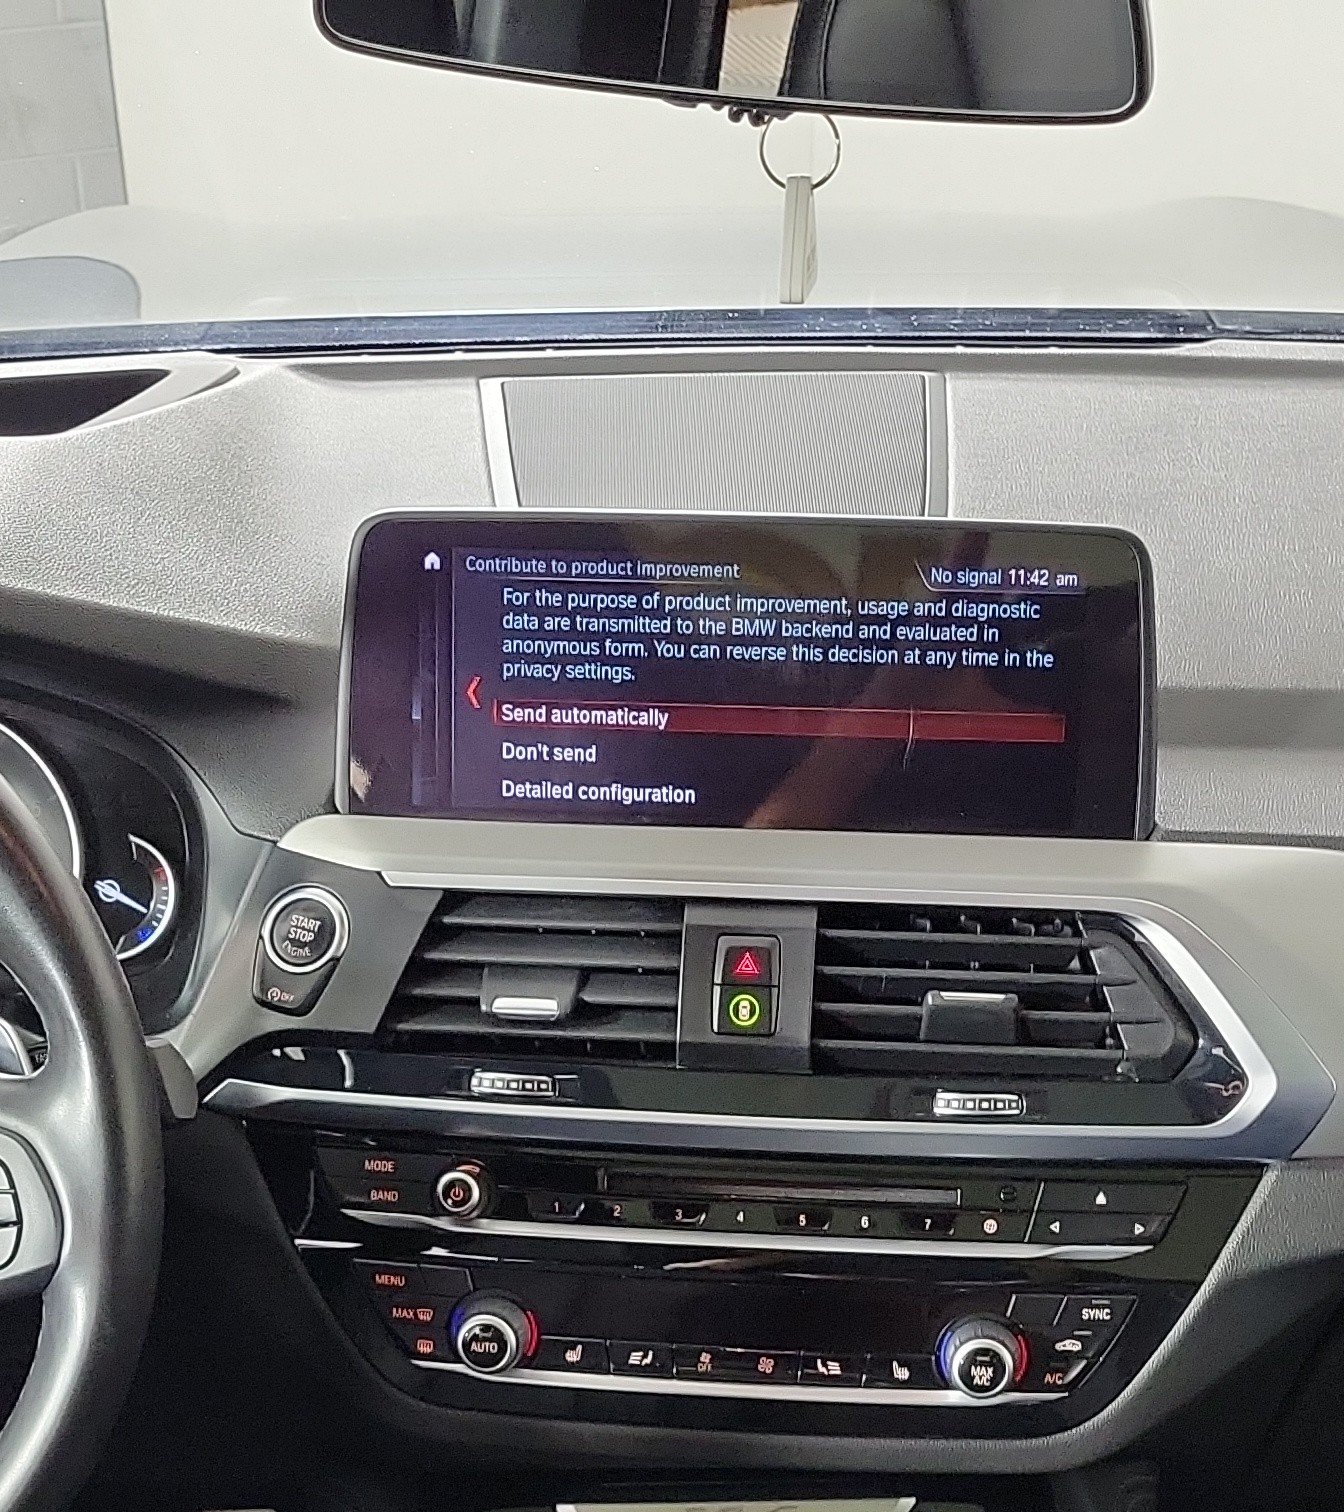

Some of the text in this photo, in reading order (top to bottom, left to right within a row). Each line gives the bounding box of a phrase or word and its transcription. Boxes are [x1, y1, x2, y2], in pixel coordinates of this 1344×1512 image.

[466, 556, 741, 580] Contribute to product improvement
[931, 567, 1001, 586] No signal
[1008, 569, 1078, 586] 11:42 am
[503, 588, 1040, 622] For the purpose of product improvement, usage and diagnostic
[503, 612, 998, 642] data are transmitted to the BMW backend and evaluated in
[503, 639, 1054, 668] anonymous form. You can reverse this decision at any time in the
[503, 660, 635, 683] privacy settings.
[502, 704, 668, 730] Send automatically
[502, 742, 596, 762] Don't send
[502, 780, 695, 804] Detailed configuration
[291, 914, 321, 932] START
[288, 928, 315, 943] STOP
[364, 1159, 396, 1173] MODE
[370, 1189, 399, 1202] BAND
[554, 1201, 560, 1213] 1
[613, 1205, 621, 1217] 2
[675, 1208, 683, 1221] 3
[736, 1210, 744, 1223] 4
[798, 1214, 806, 1227] 5
[861, 1216, 869, 1229] 6
[924, 1219, 932, 1231] 7
[375, 1274, 405, 1287] MENU
[392, 1307, 414, 1319] MAX
[1082, 1308, 1111, 1321] SYNC
[470, 1342, 498, 1354] AUTO
[971, 1365, 994, 1377] MAX
[973, 1375, 991, 1386] A/C
